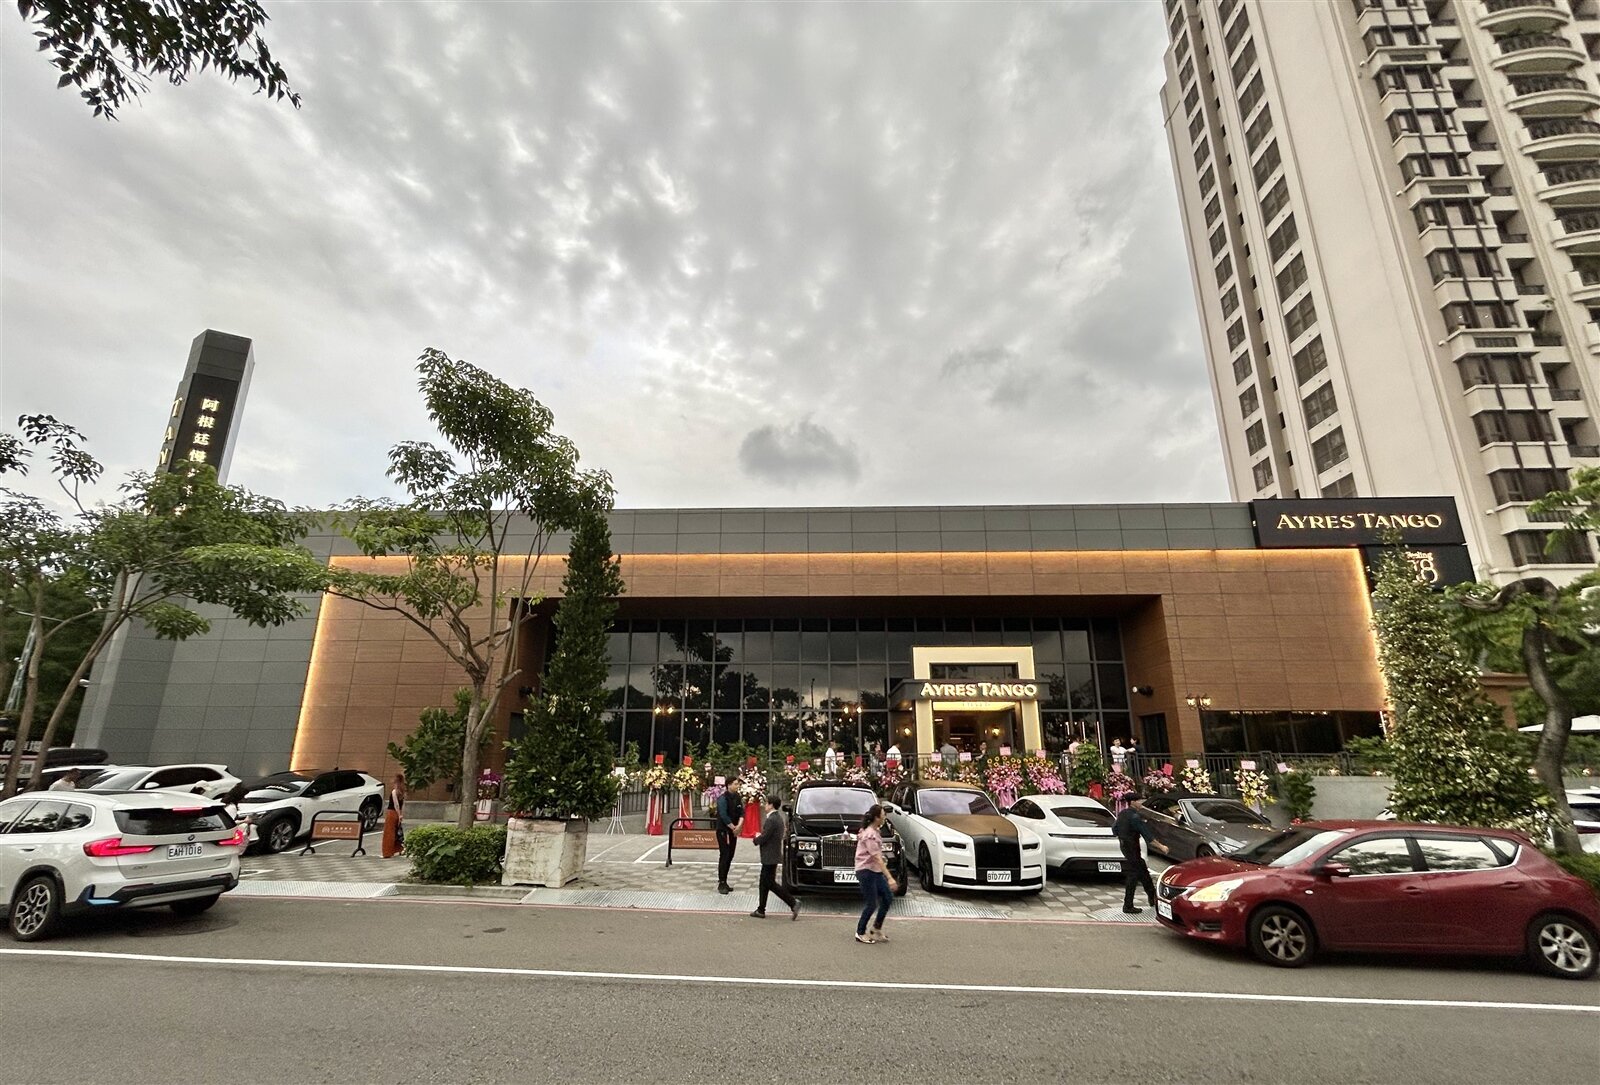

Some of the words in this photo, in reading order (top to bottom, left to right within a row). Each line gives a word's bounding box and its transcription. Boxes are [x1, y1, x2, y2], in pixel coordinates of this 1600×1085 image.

[1276, 513, 1356, 530] AYRES
[1357, 513, 1442, 529] TANGO
[920, 682, 978, 697] AYRES
[978, 682, 1038, 697] TANGO
